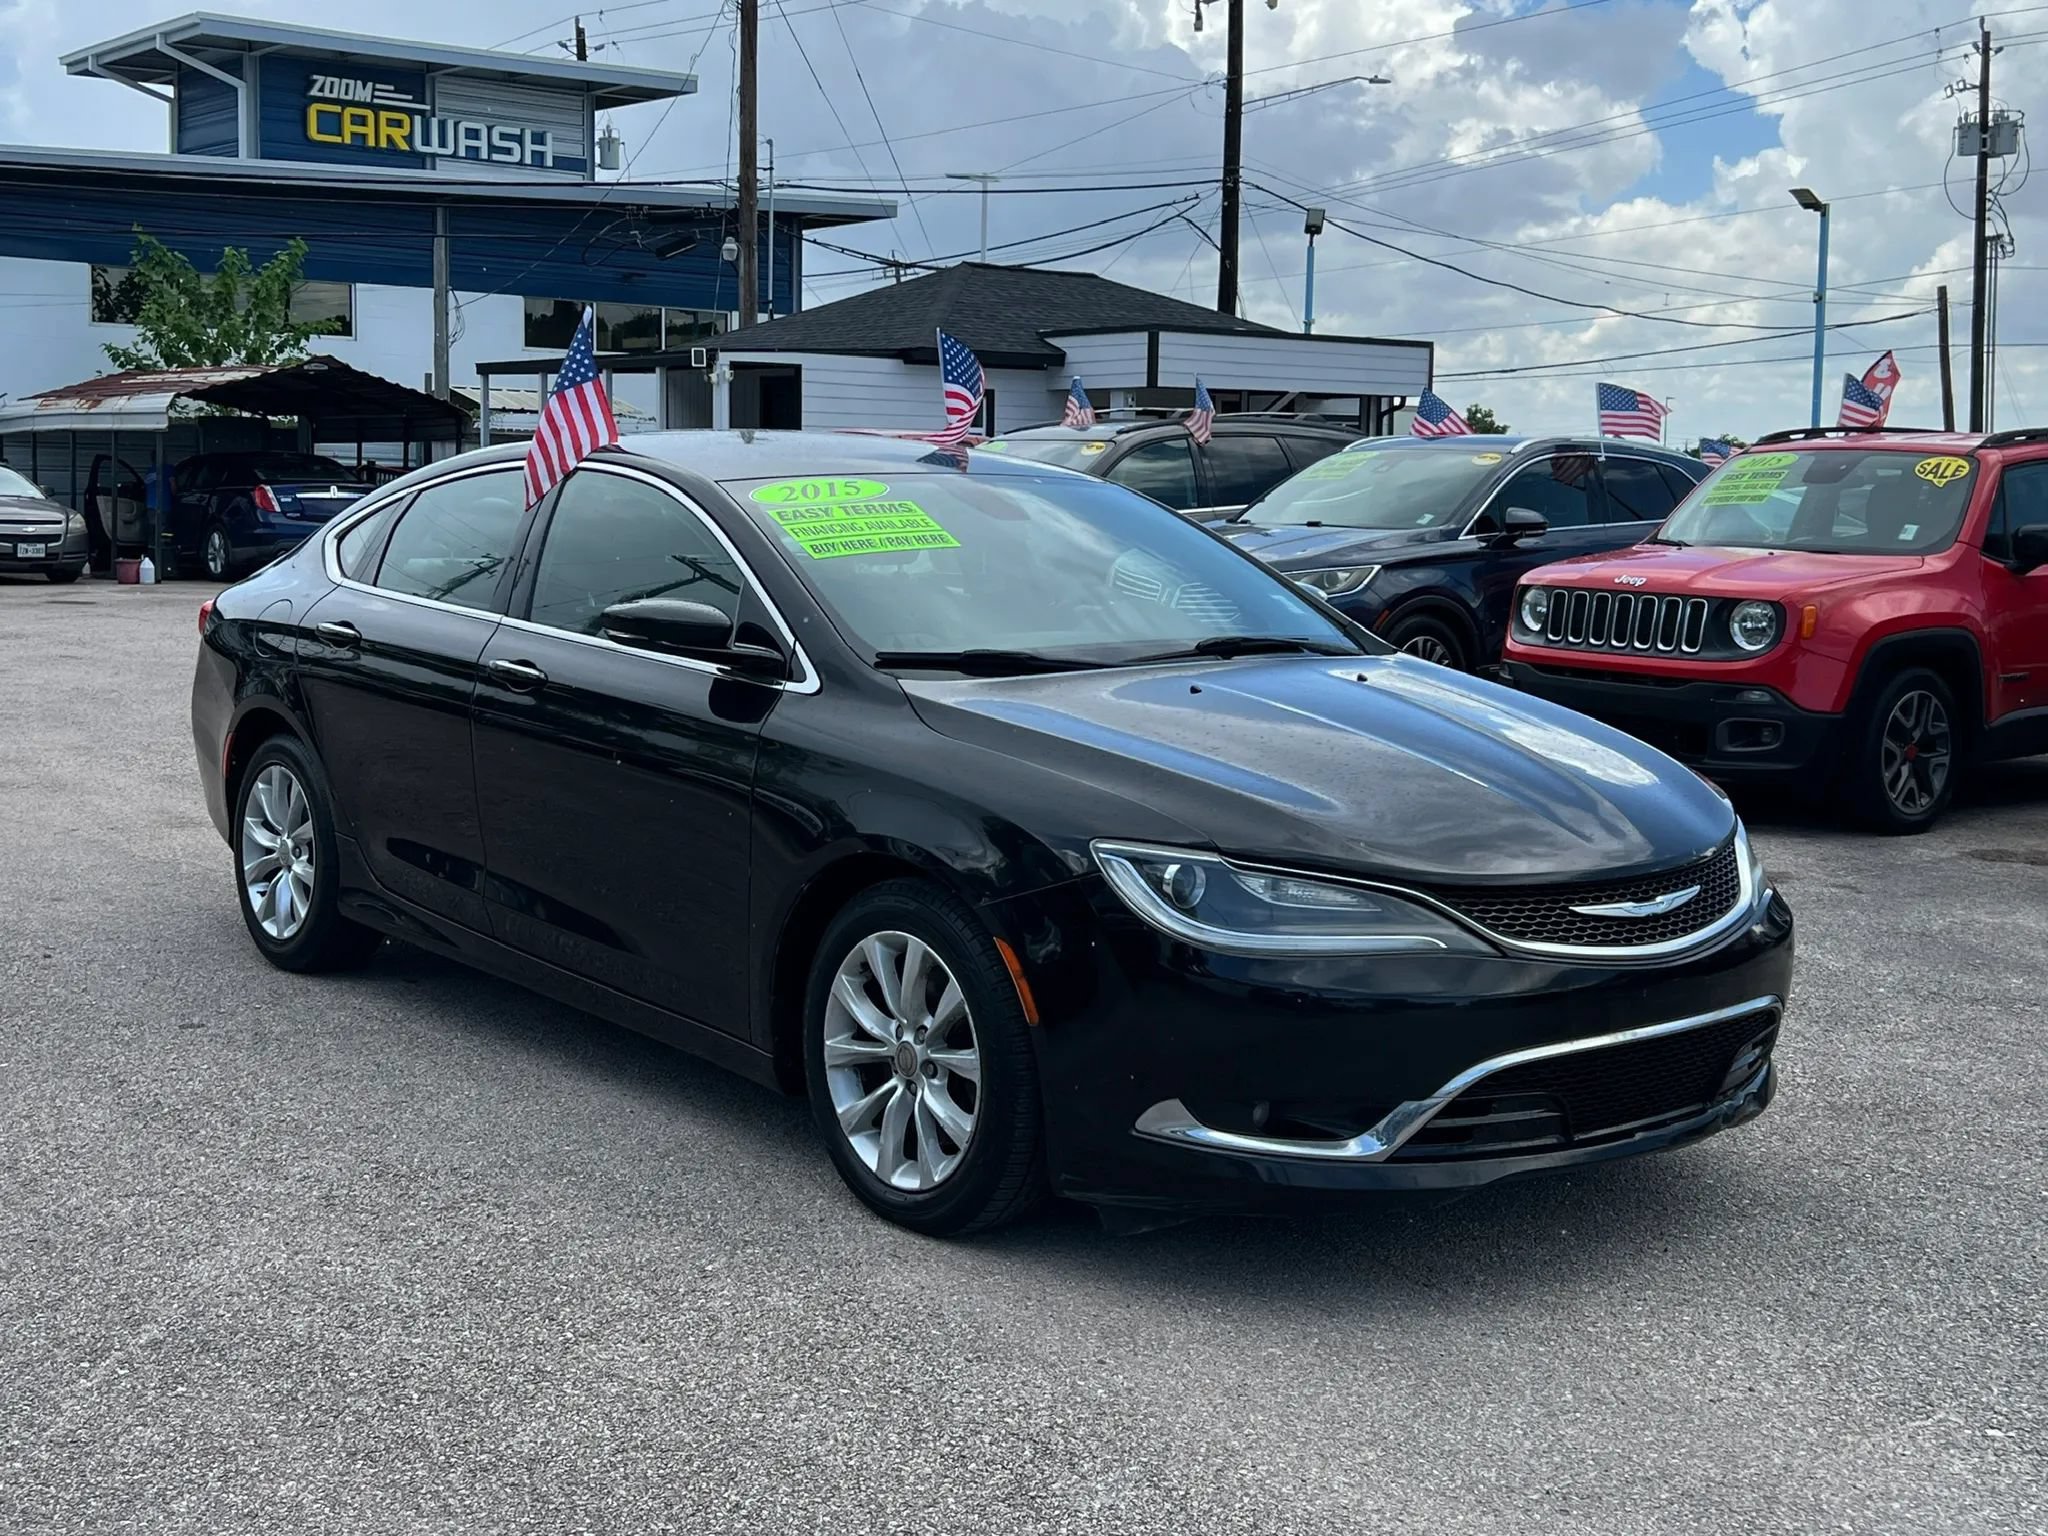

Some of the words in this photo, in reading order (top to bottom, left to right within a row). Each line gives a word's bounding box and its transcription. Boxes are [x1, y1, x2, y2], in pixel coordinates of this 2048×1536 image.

[309, 74, 373, 102] ZOOM
[1917, 461, 1967, 479] SALE
[778, 481, 861, 502] 2015
[777, 506, 833, 521] EASY
[838, 502, 914, 517] TERMS
[790, 521, 864, 538] FINANCING
[865, 518, 936, 532] AVAILABLE
[810, 542, 838, 554] BUY
[840, 539, 875, 550] HERE
[886, 536, 911, 547] PAY
[912, 533, 947, 544] HERE
[1614, 574, 1647, 587] Jeep
